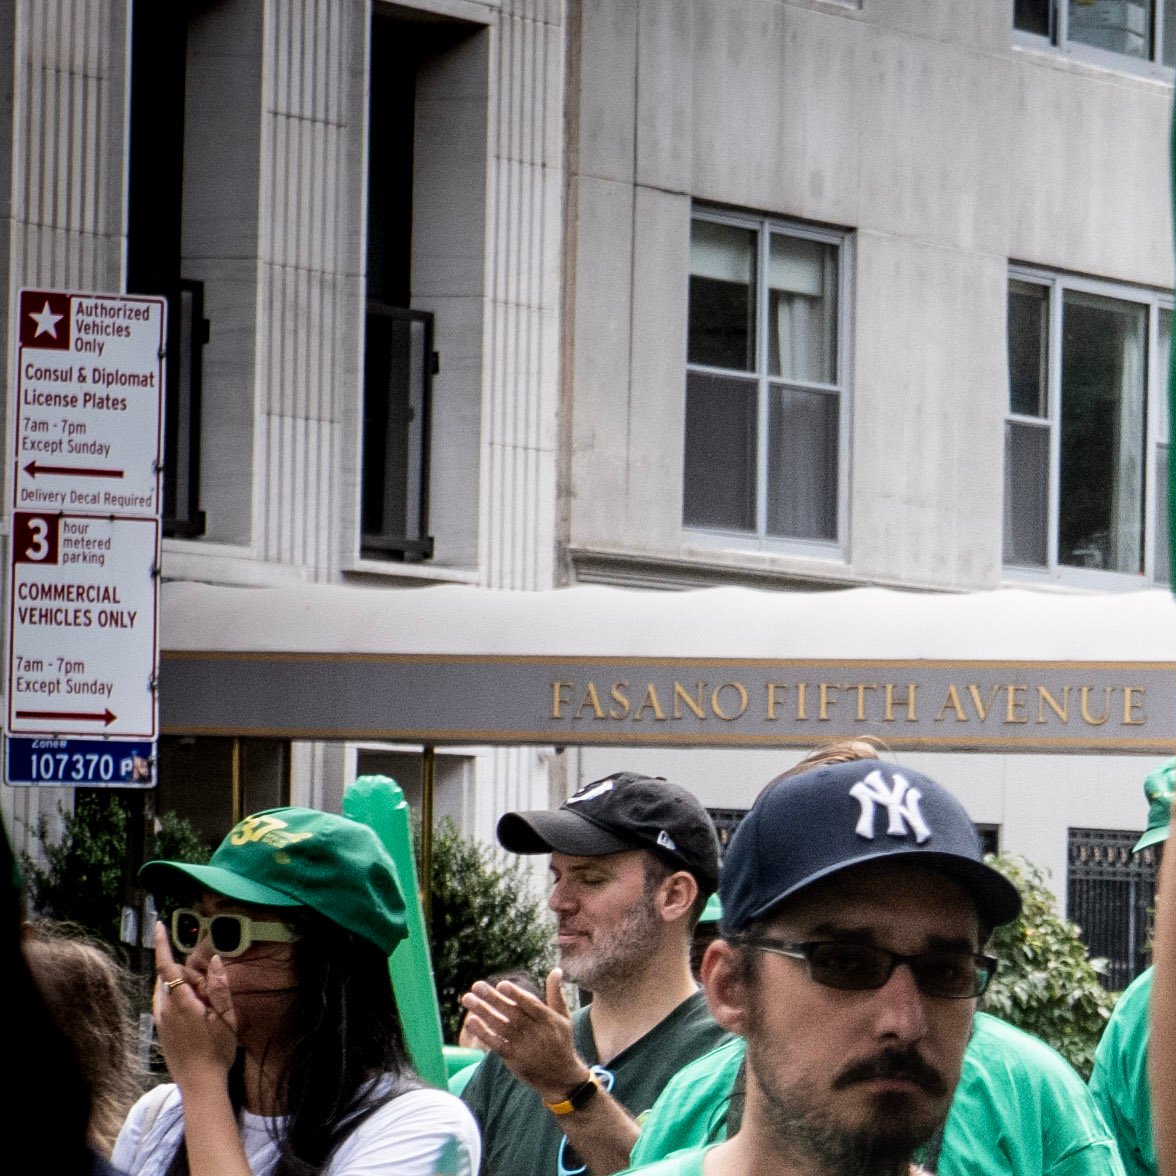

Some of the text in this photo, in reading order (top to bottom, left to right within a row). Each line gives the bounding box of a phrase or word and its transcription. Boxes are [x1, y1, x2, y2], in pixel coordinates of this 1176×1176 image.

[76, 301, 150, 321] Authorized
[76, 320, 131, 338] Vehicles
[75, 337, 105, 357] Only
[25, 364, 155, 388] Consul & Diplomat
[24, 389, 127, 411] License Plates
[23, 418, 49, 433] 7am
[61, 419, 87, 436] 7pm
[22, 437, 111, 458] Except Sunday
[21, 488, 152, 508] Delivery Decal Required
[63, 520, 89, 534] hour
[25, 517, 49, 560] 3
[63, 537, 111, 550] metered
[62, 552, 105, 567] parking
[18, 582, 120, 604] COMMERCIAL
[18, 607, 137, 628] VEHICLES ONLY
[16, 656, 43, 673] 7am
[57, 658, 84, 676] 7pm
[16, 677, 113, 698] Except Sunday
[551, 680, 1147, 726] FASANO FIFTH AVENUE
[31, 753, 114, 780] 107370
[848, 770, 931, 843] NY
[231, 815, 288, 845] 37
